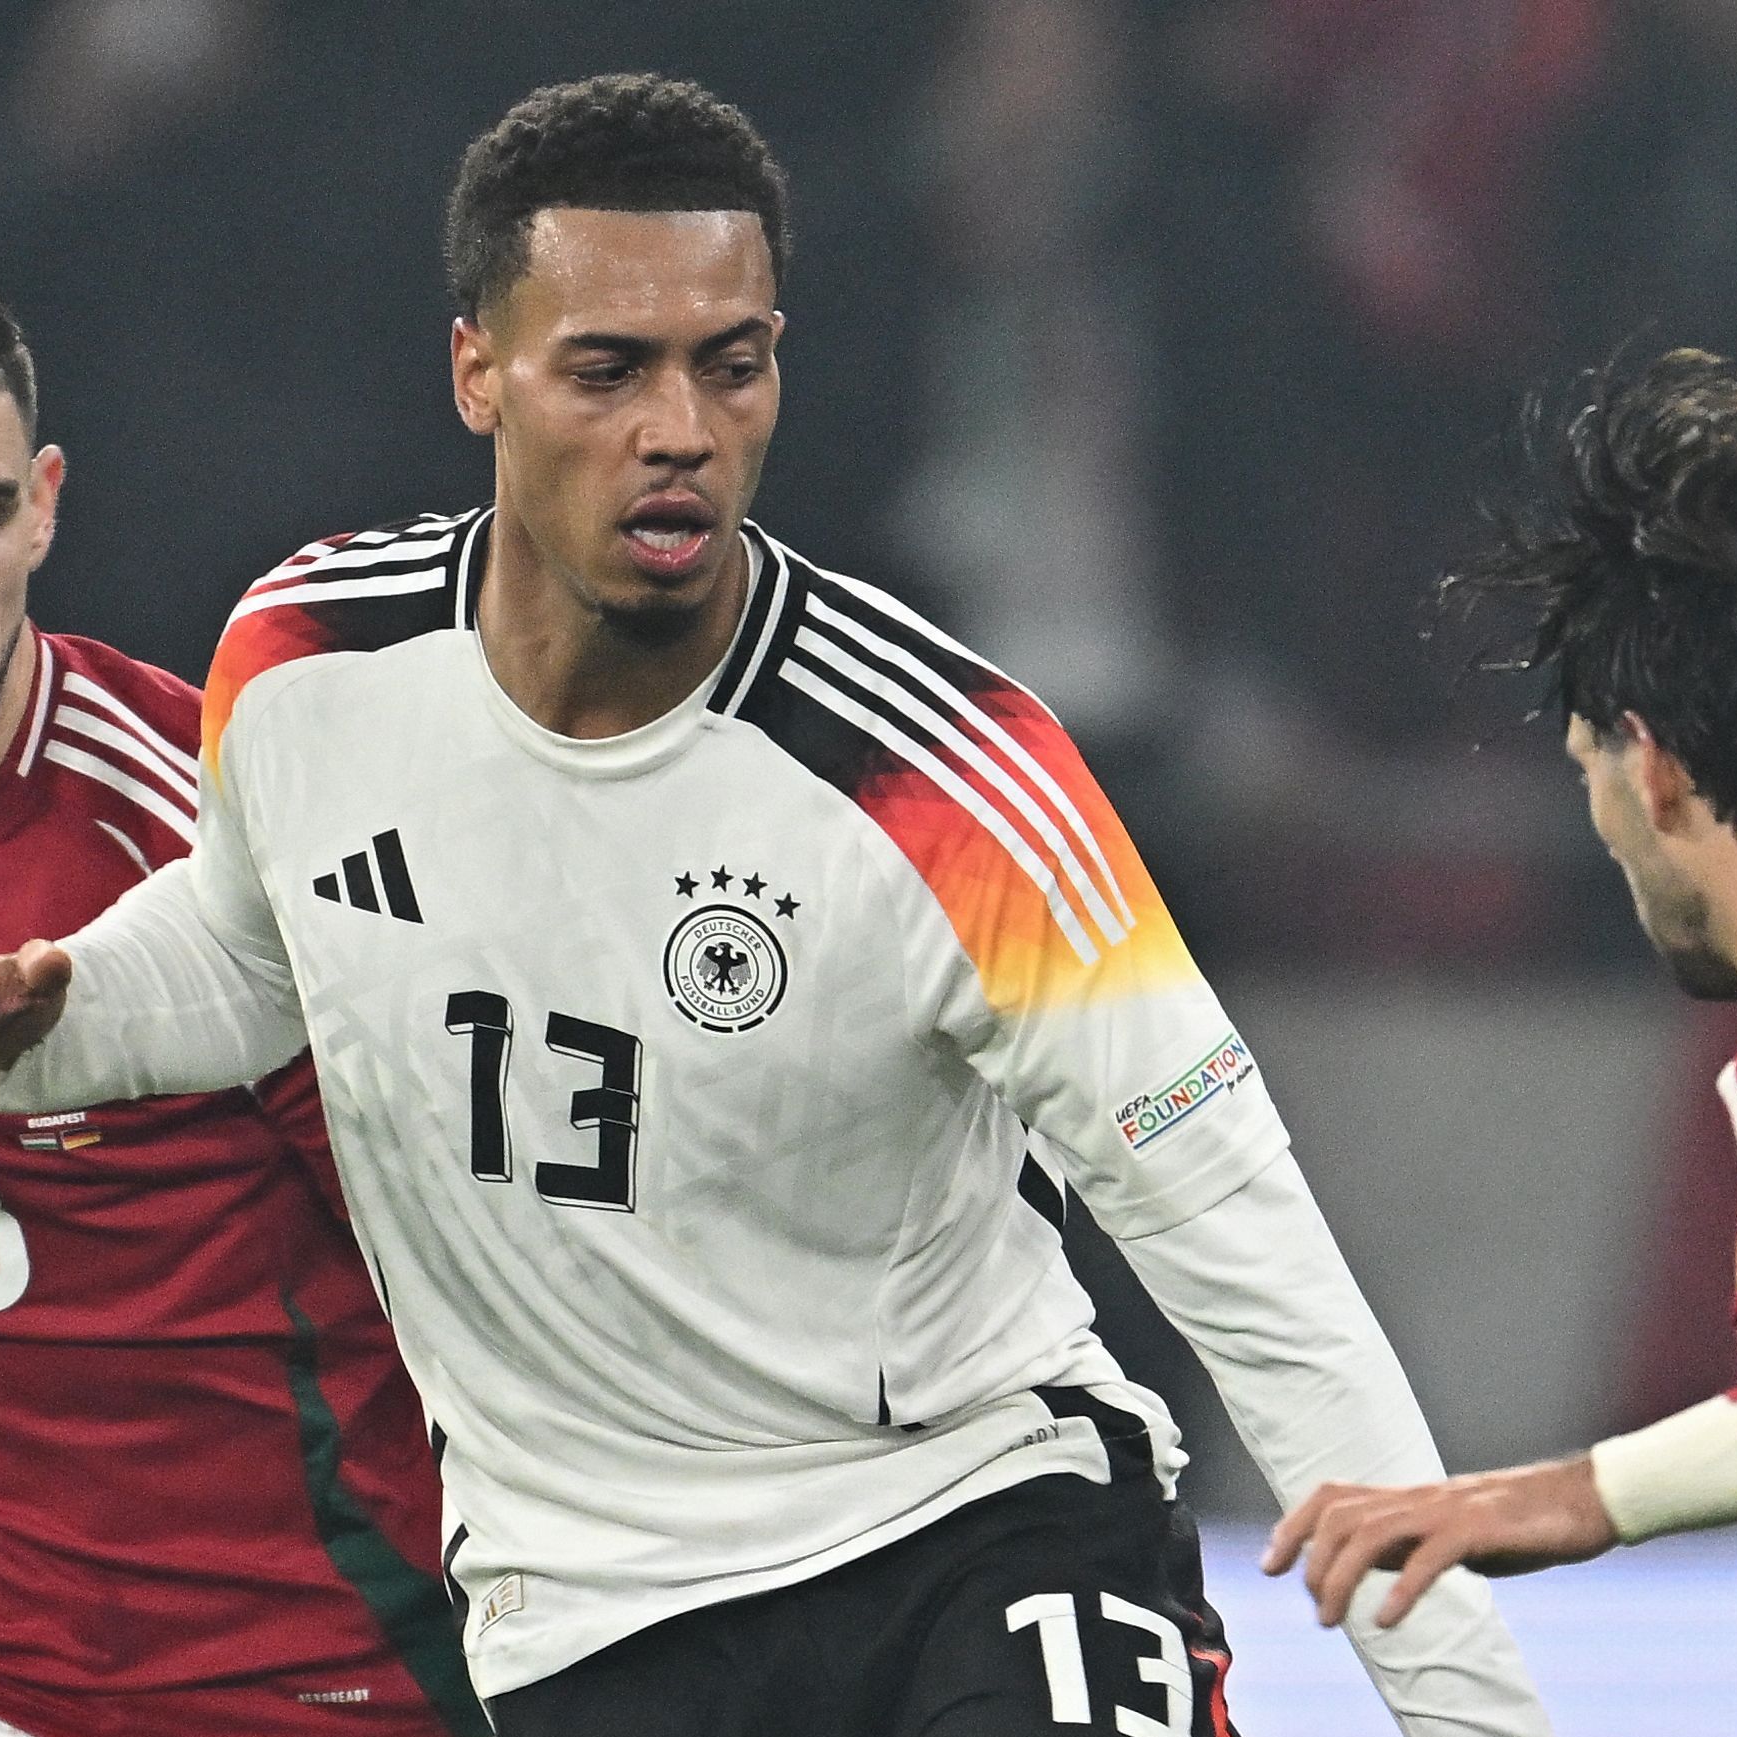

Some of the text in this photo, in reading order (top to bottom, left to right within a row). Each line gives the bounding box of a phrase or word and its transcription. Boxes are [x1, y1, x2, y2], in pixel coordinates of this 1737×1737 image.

[693, 921, 762, 951] DEUTSCHER
[679, 974, 765, 1016] FUSSBALL-BUND
[444, 989, 644, 1215] 13
[1115, 1093, 1152, 1124] UEFA
[1121, 1039, 1247, 1144] FOUNDATION
[27, 1111, 86, 1129] BUDAPEST
